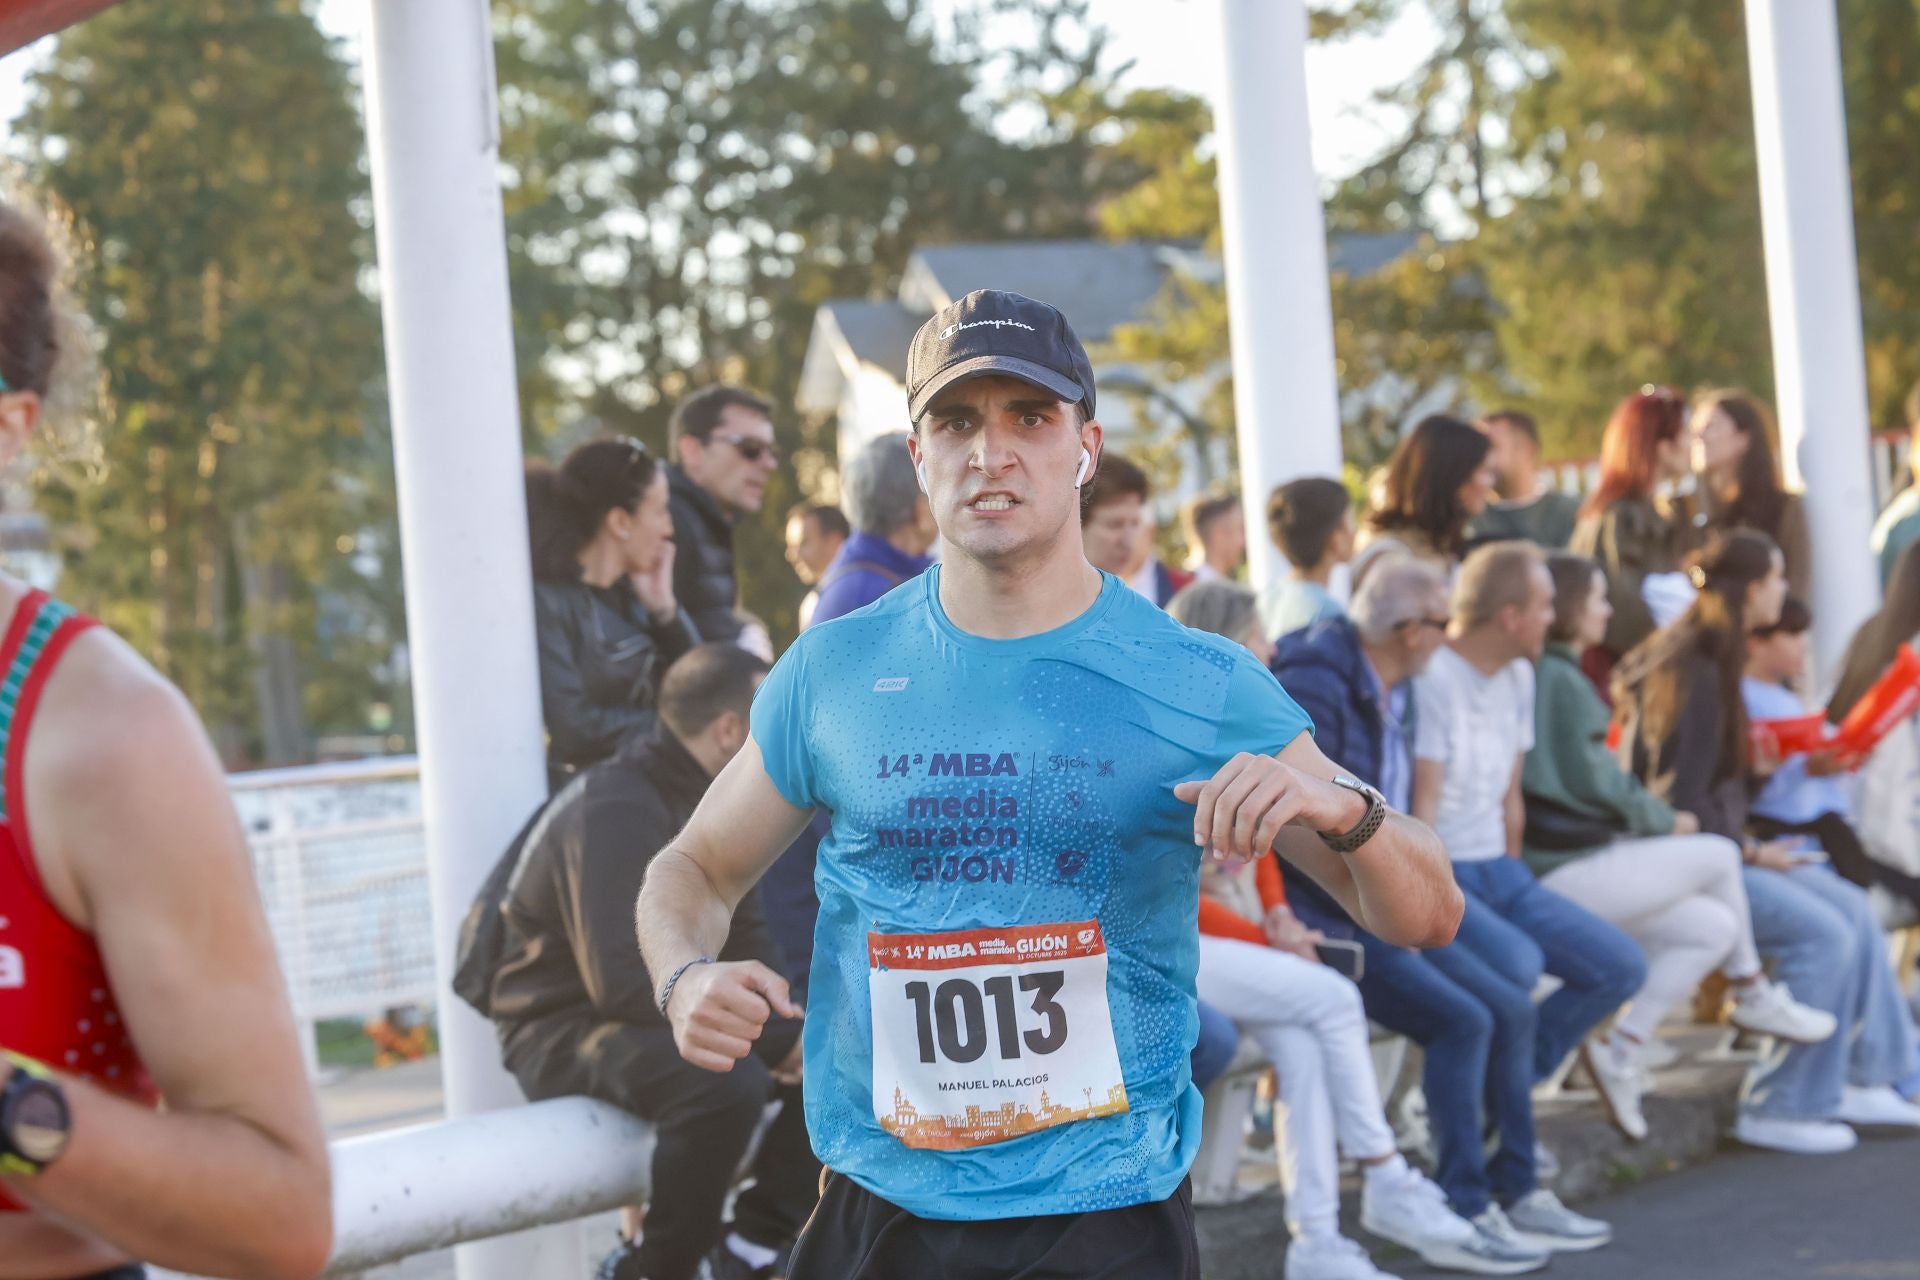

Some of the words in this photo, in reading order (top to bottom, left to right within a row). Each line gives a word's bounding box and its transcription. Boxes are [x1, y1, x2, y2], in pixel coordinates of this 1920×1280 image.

[940, 319, 1035, 339] Champion
[907, 789, 1018, 819] media
[877, 821, 1018, 848] maratón
[910, 850, 1014, 885] GIJÓN
[928, 942, 977, 960] MBA
[979, 938, 1006, 948] media
[1016, 934, 1068, 954] GIJÓN
[904, 970, 1068, 1064] 1013
[938, 1079, 990, 1091] MANUEL
[992, 1073, 1049, 1089] PALACIOS
